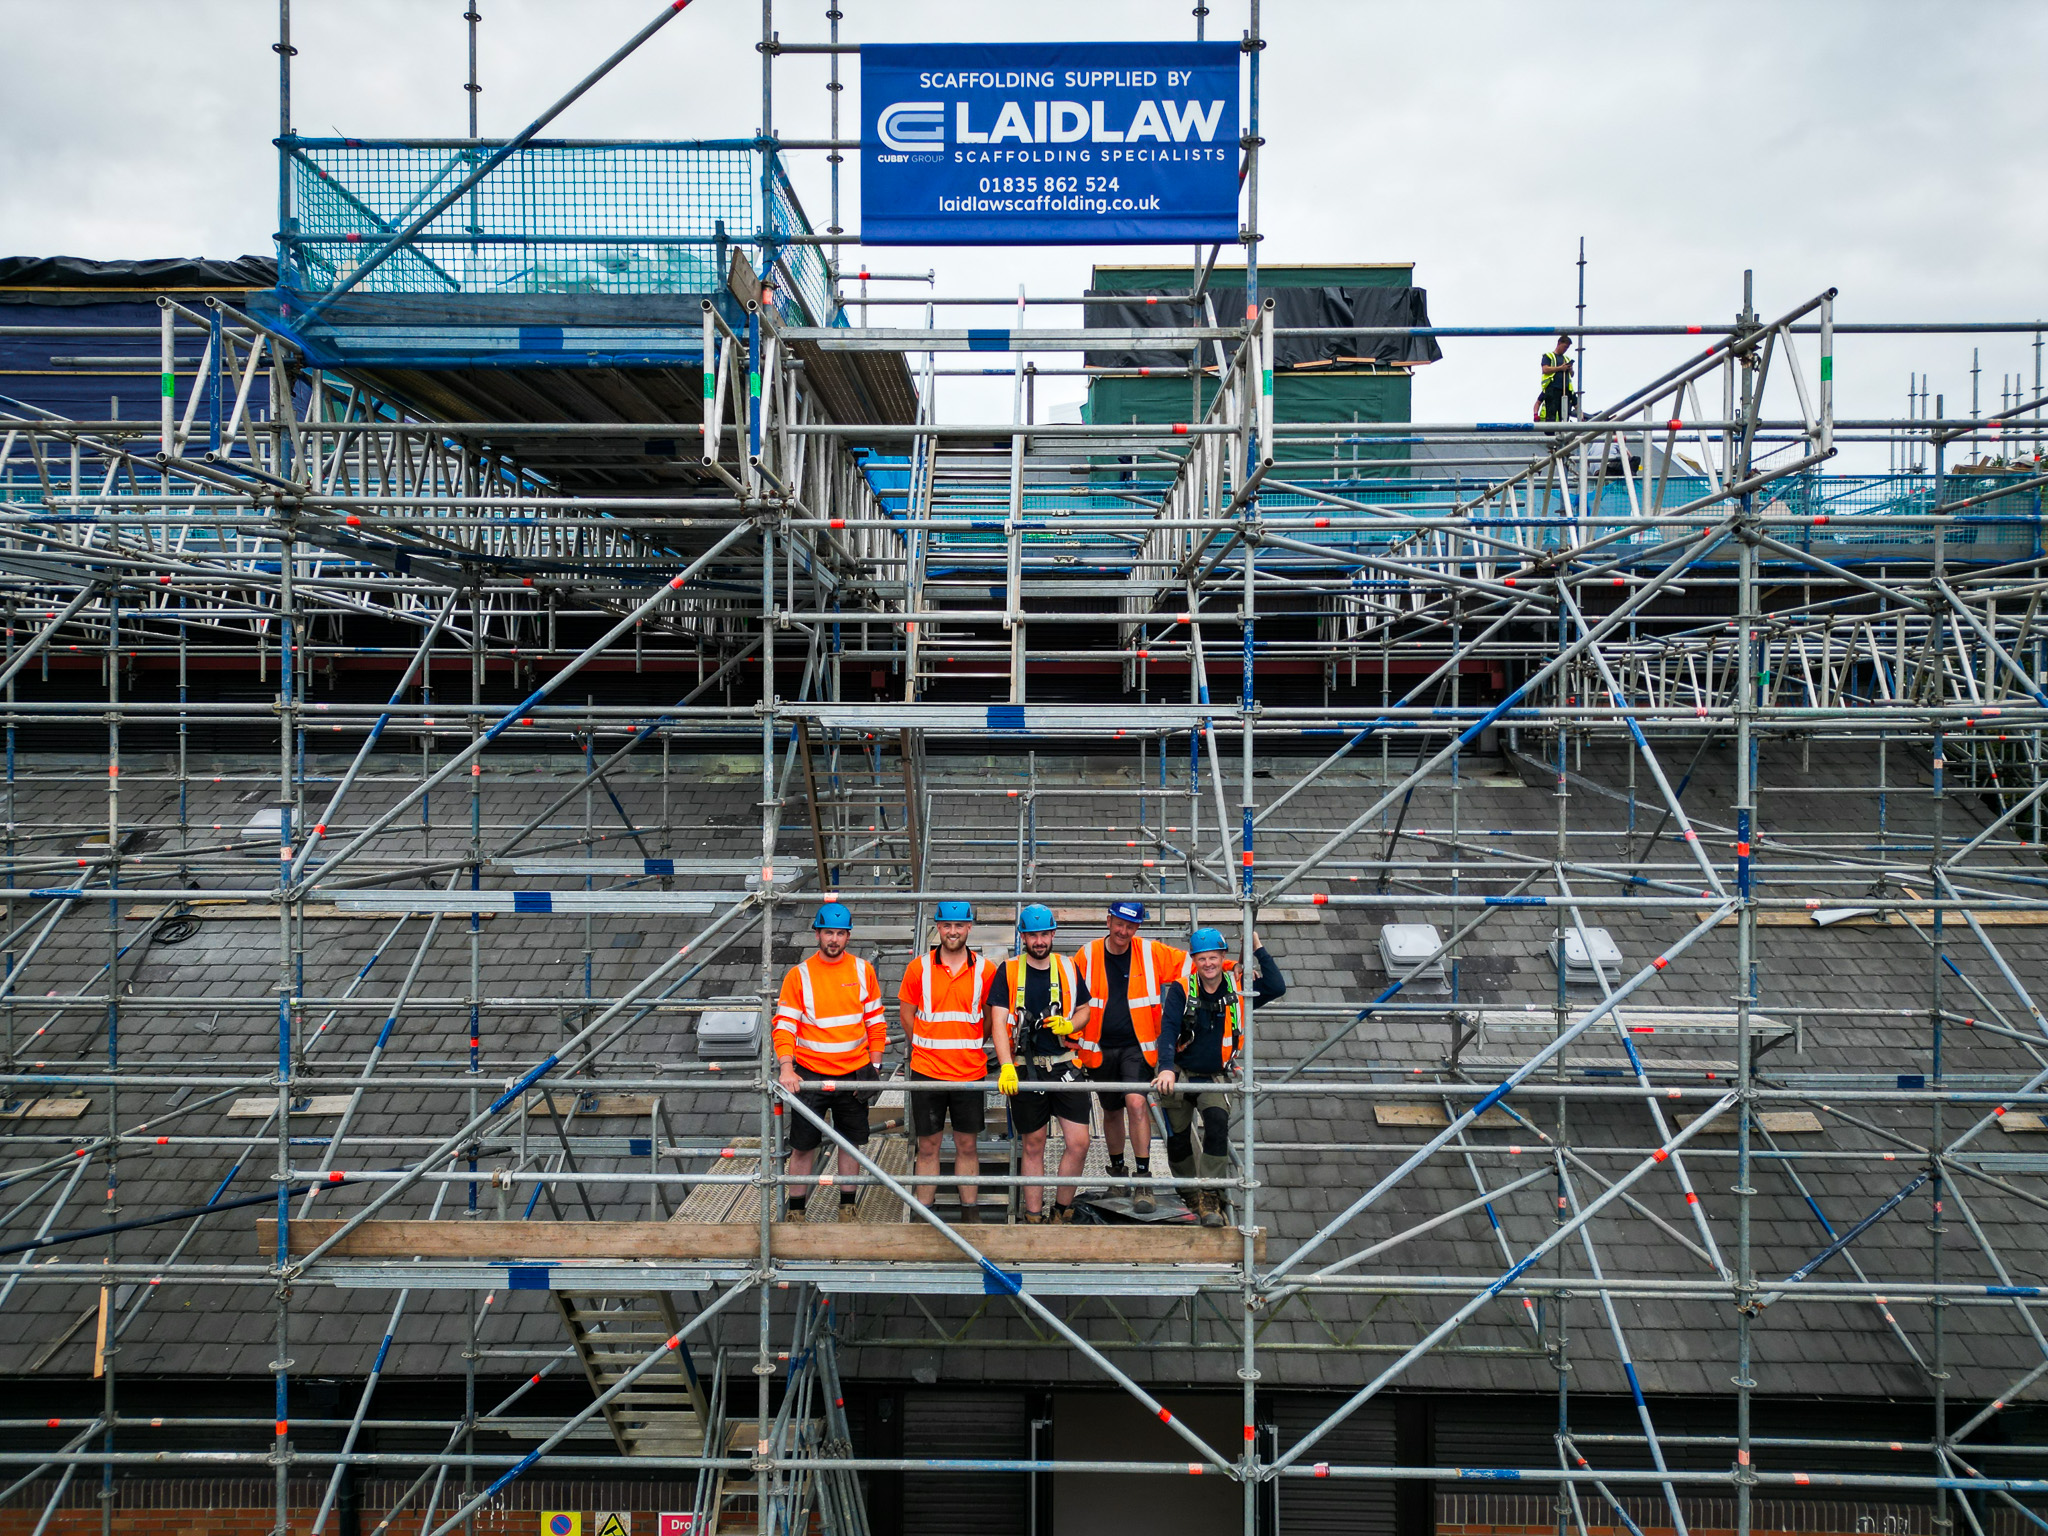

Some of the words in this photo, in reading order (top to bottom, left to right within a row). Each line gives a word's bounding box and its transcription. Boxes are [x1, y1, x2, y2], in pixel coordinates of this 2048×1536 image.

[920, 72, 1055, 89] SCAFFOLDING
[1065, 71, 1157, 88] SUPPLIED
[1168, 71, 1192, 87] BY
[956, 100, 1226, 144] LAIDLAW
[877, 154, 909, 163] CUBBY
[911, 154, 945, 163] GROUP
[954, 150, 1091, 163] SCAFFOLDING
[1101, 148, 1225, 162] SPECIALISTS
[979, 177, 1038, 193] 01835
[1044, 177, 1078, 193] 862
[1085, 177, 1120, 192] 524
[939, 195, 1160, 214] laidlawscaffolding.co.uk
[671, 1519, 694, 1530] Dro
